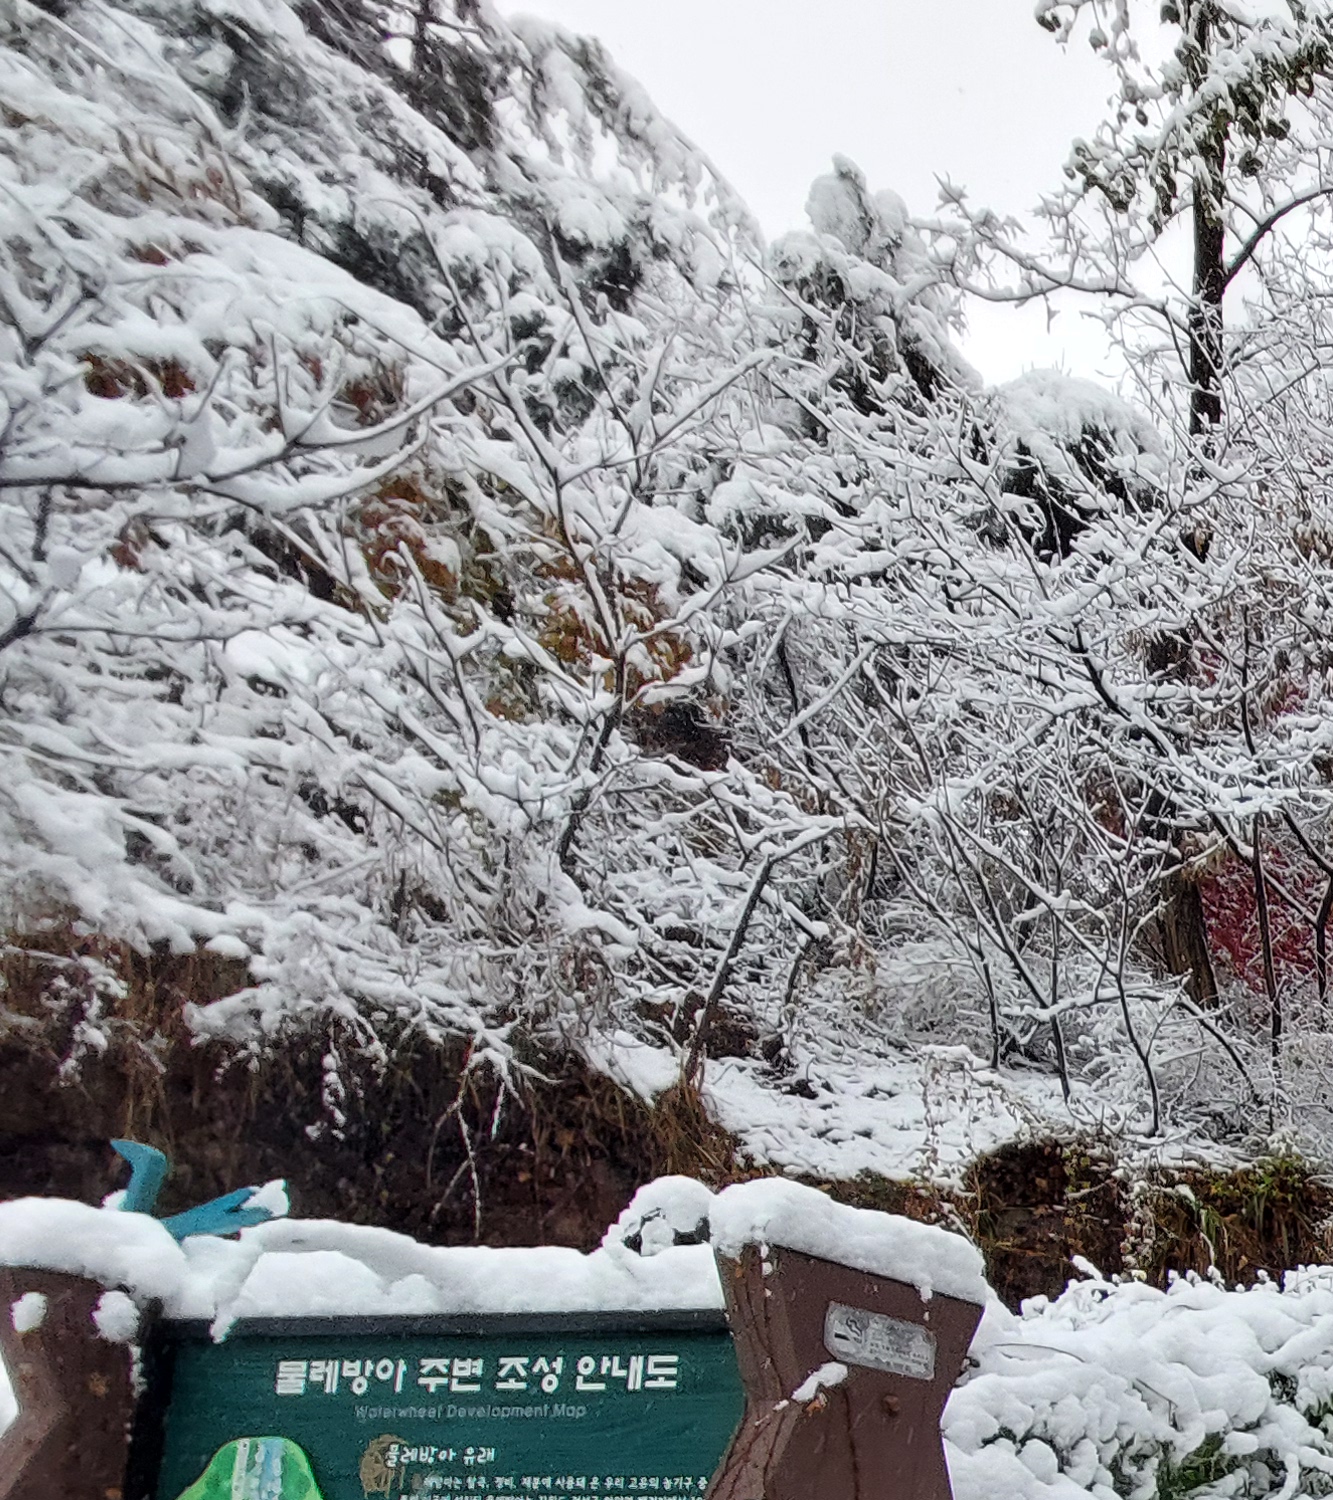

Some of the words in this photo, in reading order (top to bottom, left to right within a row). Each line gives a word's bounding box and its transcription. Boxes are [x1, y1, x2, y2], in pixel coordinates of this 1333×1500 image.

[275, 1358, 407, 1395] 물레방아
[417, 1357, 484, 1393] 주변
[495, 1356, 563, 1393] 조성
[575, 1355, 680, 1391] 안내도
[355, 1404, 442, 1420] Waterwheel
[446, 1404, 550, 1420] Development
[551, 1404, 587, 1420] Map
[385, 1444, 456, 1468] 물레방아
[463, 1446, 495, 1466] 유래
[604, 1476, 624, 1490] 우리
[662, 1476, 693, 1491] 농기구
